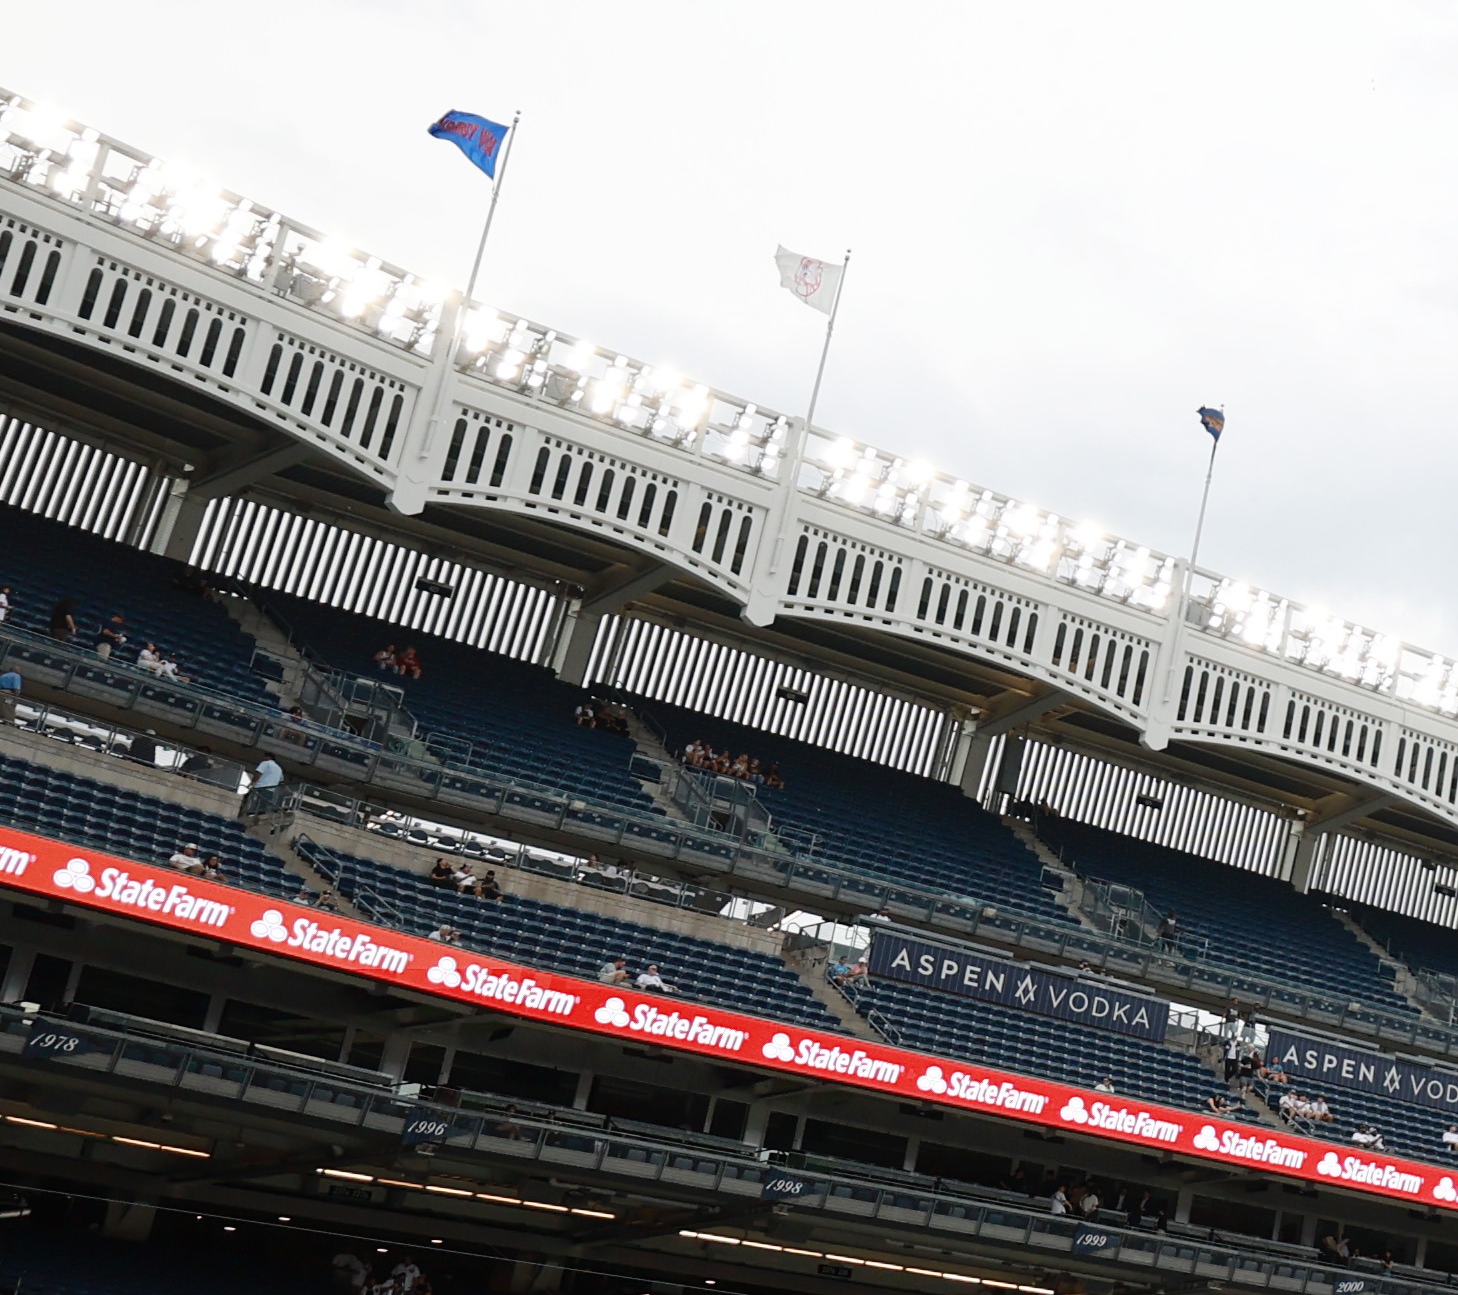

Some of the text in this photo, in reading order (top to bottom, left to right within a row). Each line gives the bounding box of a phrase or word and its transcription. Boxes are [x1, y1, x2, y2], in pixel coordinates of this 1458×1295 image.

[891, 948, 1150, 1029] ASPEN VODKA
[29, 1032, 80, 1052] 1978
[1282, 1044, 1375, 1083] ASPEN
[407, 1120, 449, 1137] 1996
[766, 1178, 803, 1194] 1998
[1076, 1233, 1108, 1248] 1999
[1336, 1281, 1365, 1293] 2000
